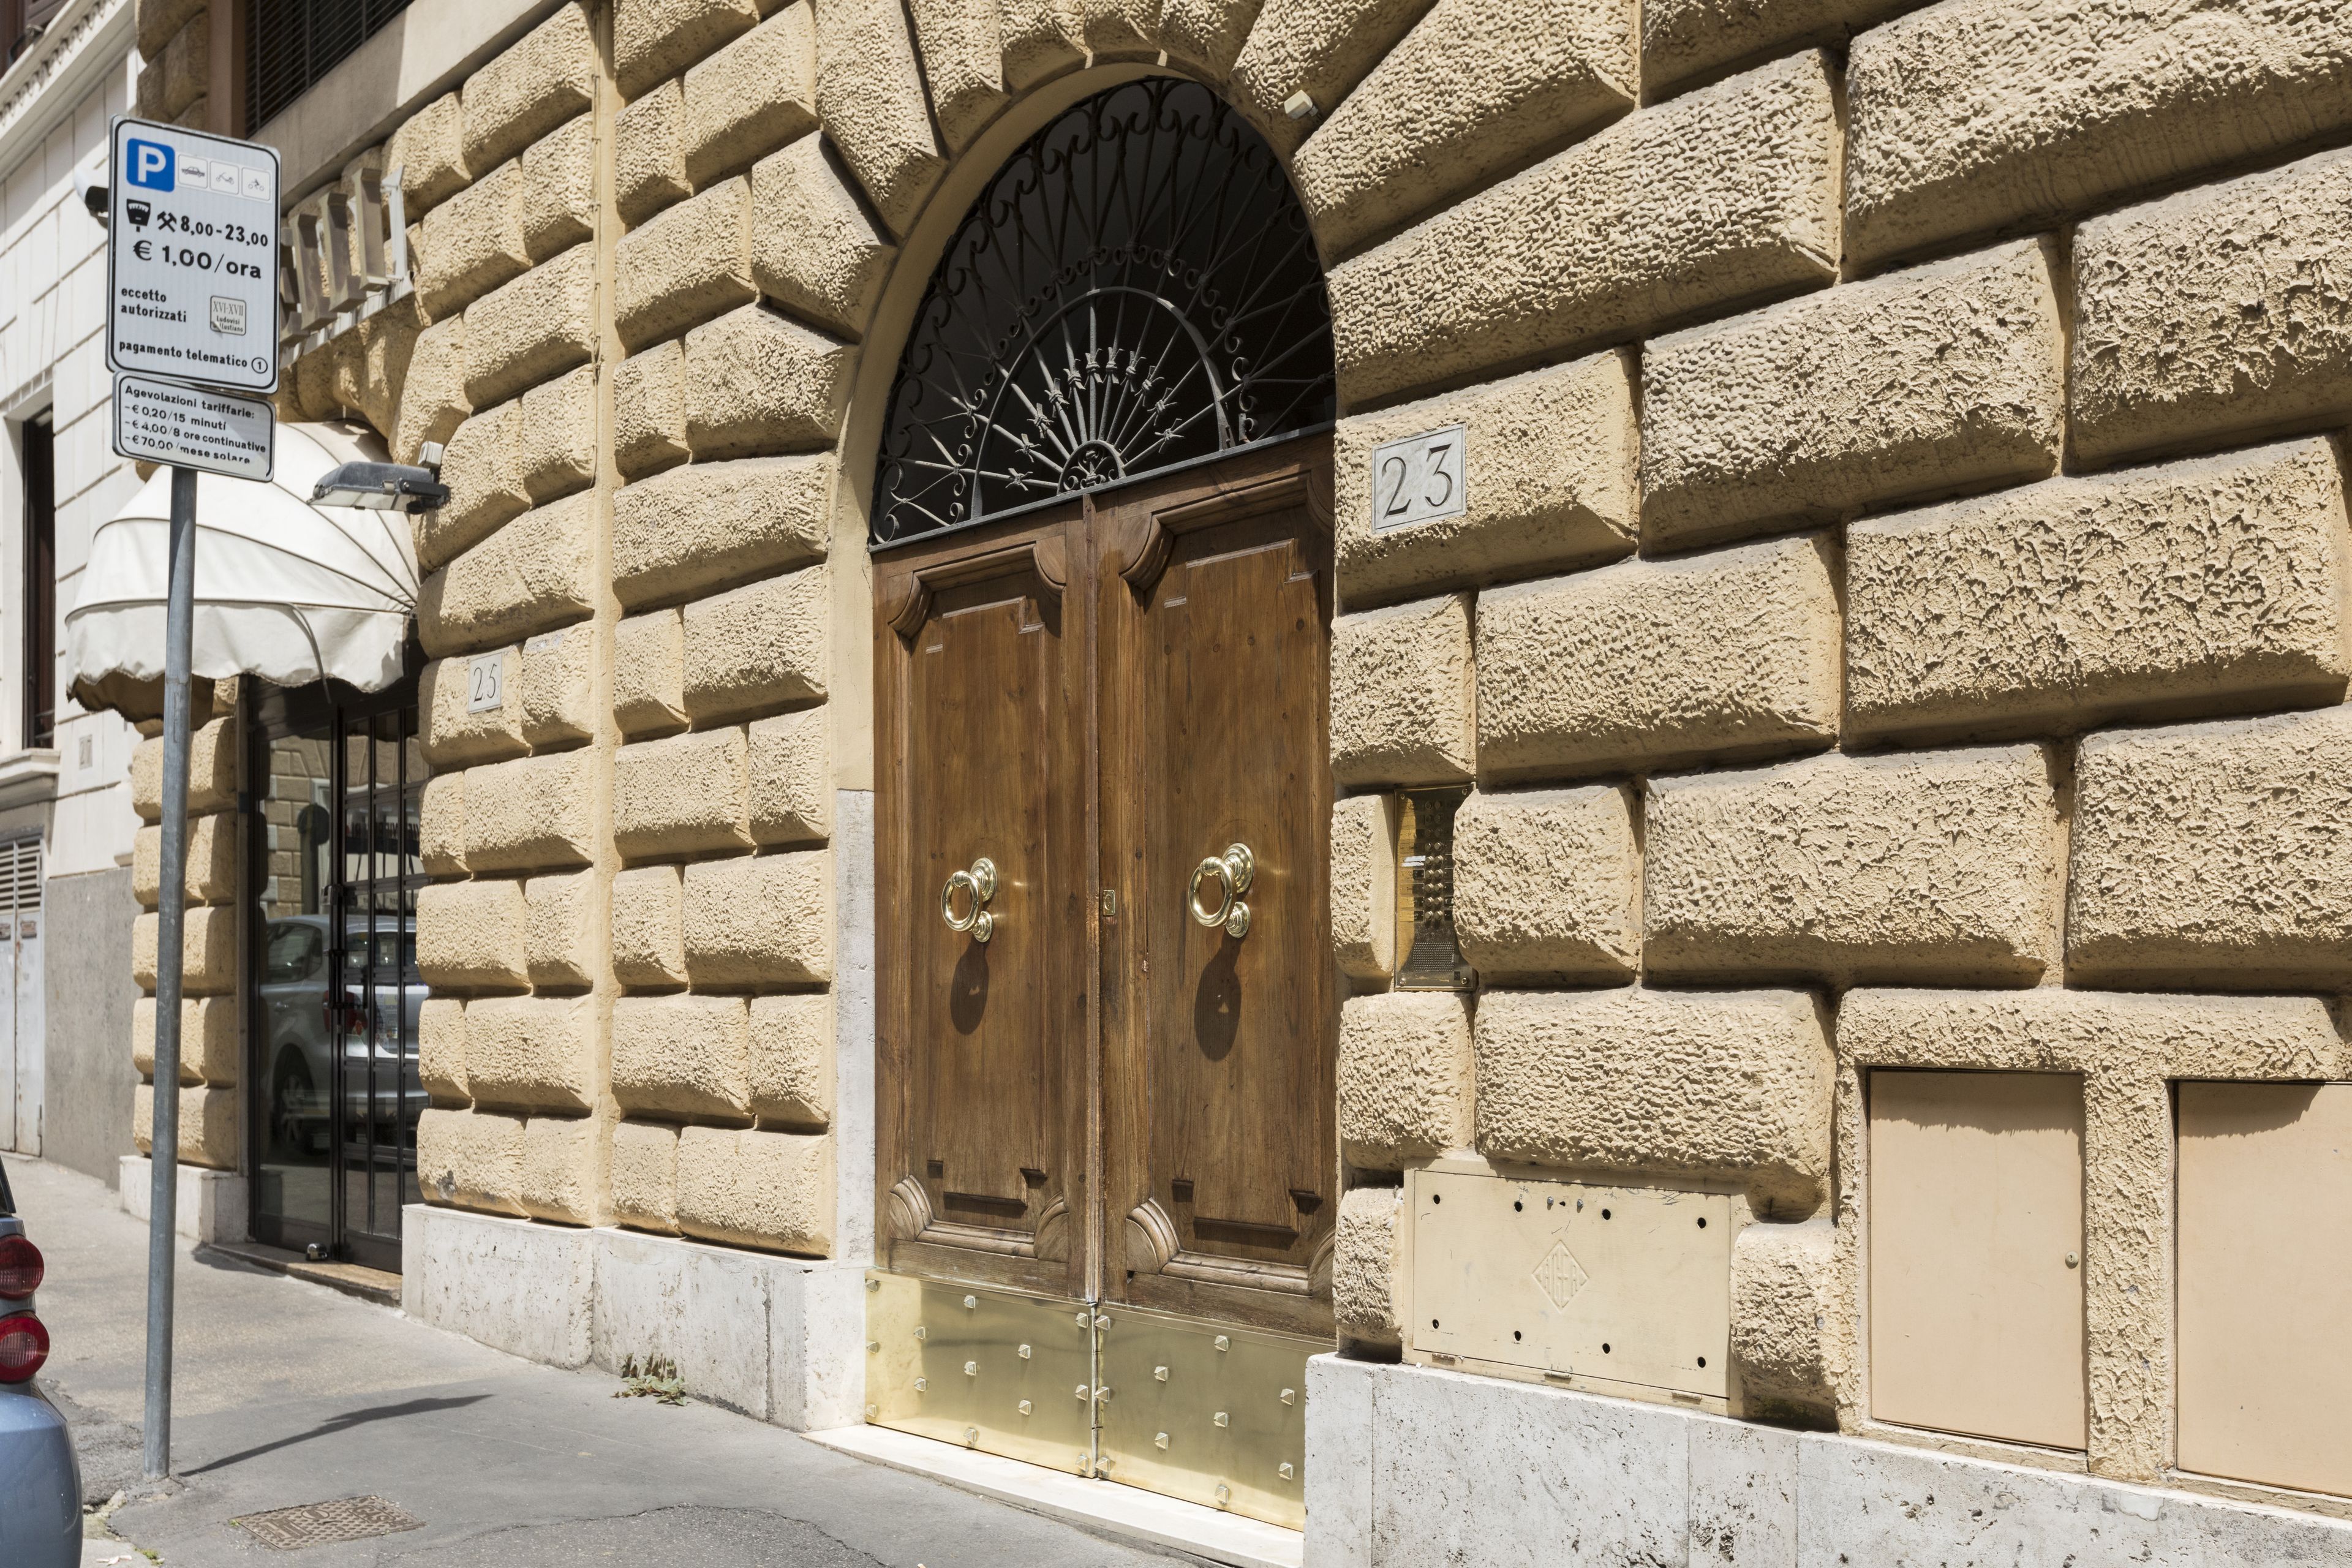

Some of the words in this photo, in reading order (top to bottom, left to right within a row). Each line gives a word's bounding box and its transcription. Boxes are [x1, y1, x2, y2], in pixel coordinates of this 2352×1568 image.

[138, 145, 166, 183] P
[121, 288, 167, 303] eccetto
[121, 304, 187, 323] autorizzati
[217, 315, 240, 325] Ludovisi
[119, 341, 182, 358] pagamento
[186, 349, 247, 368] telematico
[125, 385, 197, 407] Agevolazioni
[202, 400, 254, 419] tariffarie:
[191, 417, 226, 431] minuti
[184, 431, 200, 441] ore
[202, 435, 266, 453] continuative
[213, 452, 251, 464] solare
[1381, 443, 1453, 519] 23
[473, 663, 497, 703] 25
